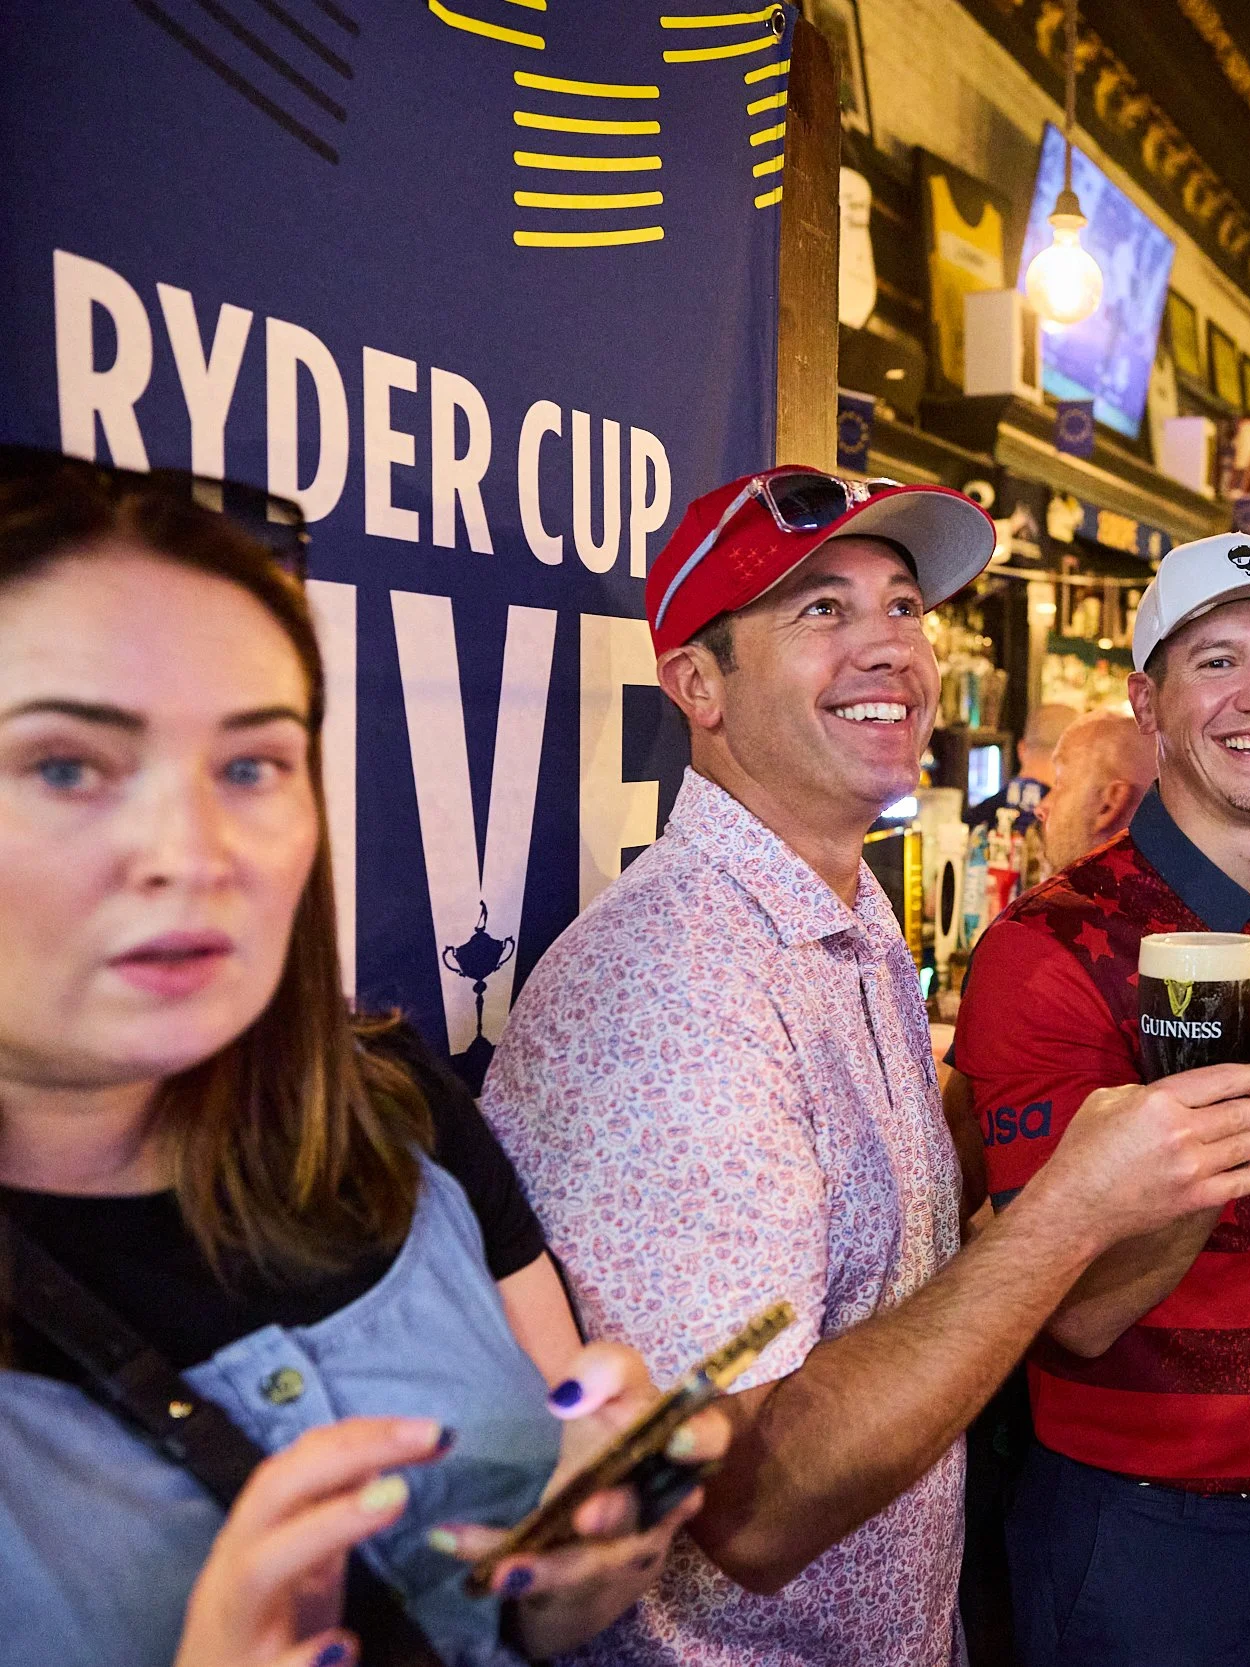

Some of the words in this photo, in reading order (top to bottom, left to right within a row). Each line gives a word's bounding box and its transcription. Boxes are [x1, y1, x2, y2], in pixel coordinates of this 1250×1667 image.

[54, 248, 494, 554] RYDER
[518, 400, 672, 579] CUP
[305, 579, 662, 1056] IVE
[1141, 1013, 1222, 1039] GUINNESS
